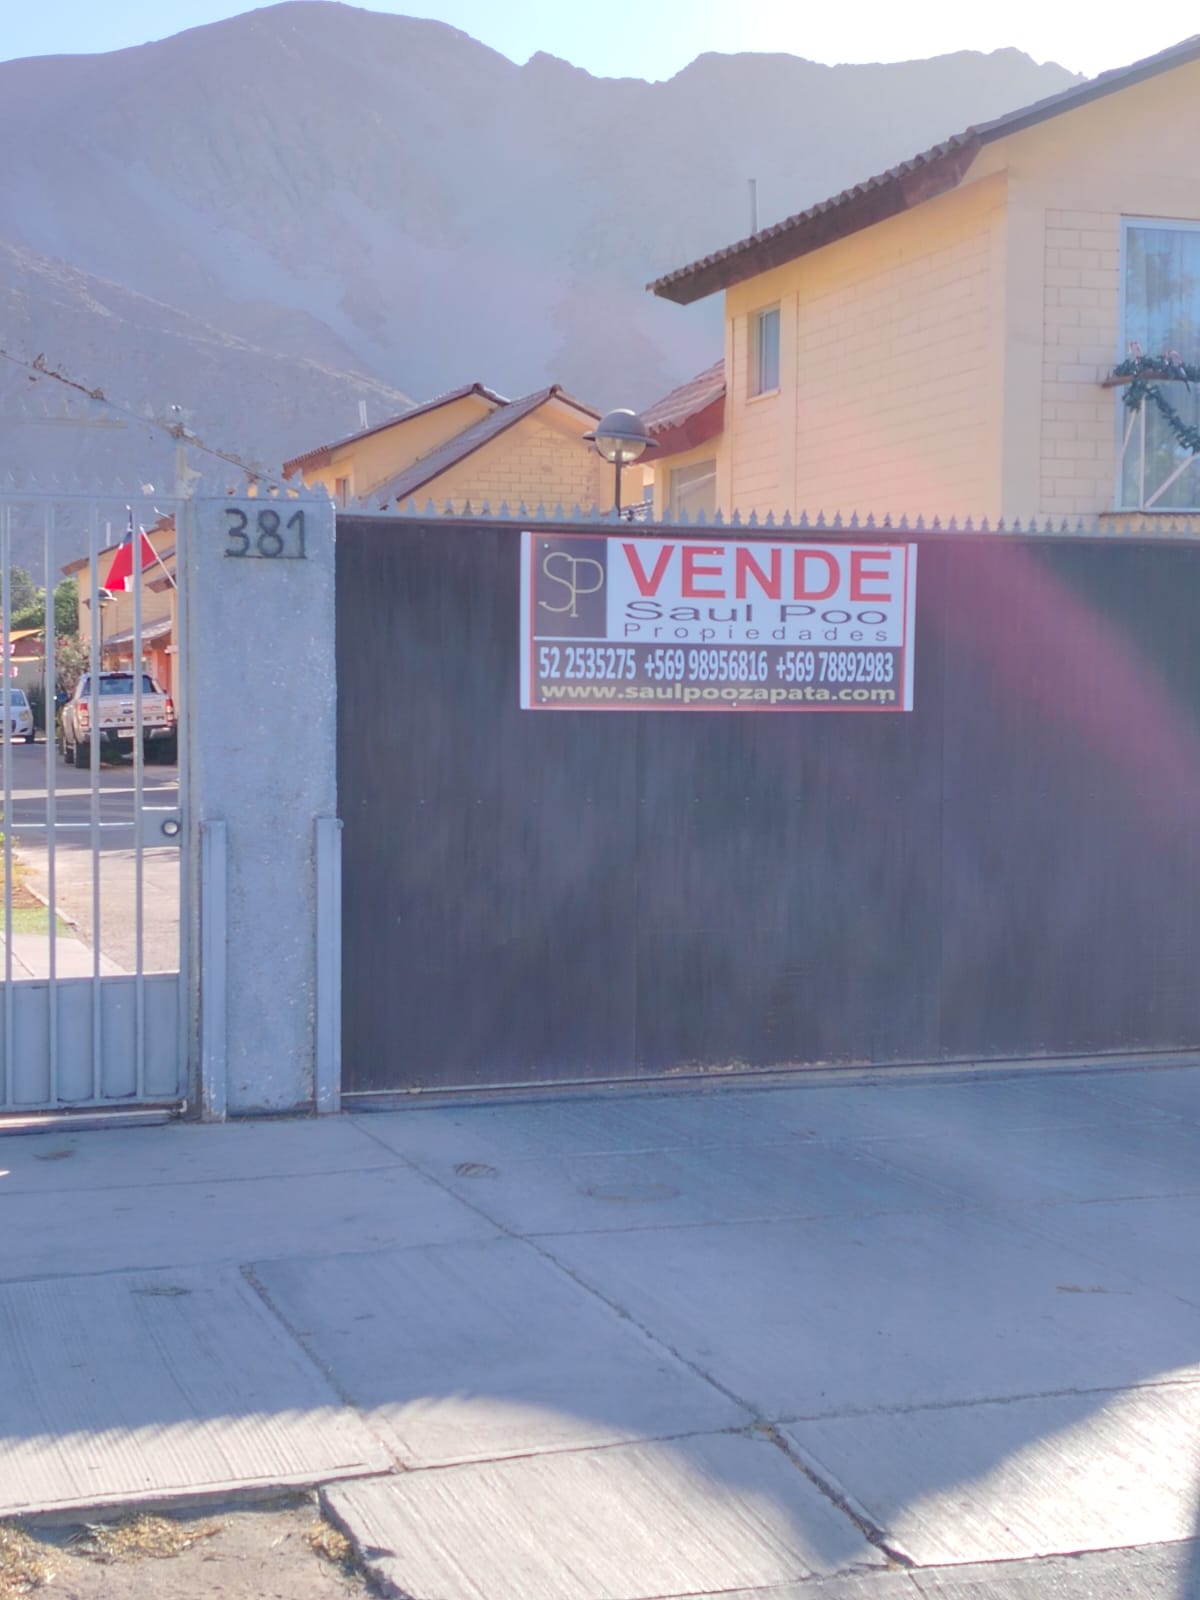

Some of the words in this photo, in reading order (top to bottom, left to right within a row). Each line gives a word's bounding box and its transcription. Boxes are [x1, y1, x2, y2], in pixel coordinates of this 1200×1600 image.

[224, 507, 306, 557] 381
[622, 543, 893, 603] VENDE
[624, 600, 753, 623] Saul
[780, 605, 888, 625] Poo
[624, 622, 889, 643] Propiedades
[539, 646, 561, 679] 52
[564, 647, 637, 680] 2535275
[644, 649, 685, 681] +569
[688, 649, 768, 682] 98956816
[776, 652, 815, 682] +569
[818, 652, 894, 683] 78892983
[541, 683, 896, 704] www.saulpoozapata.com
